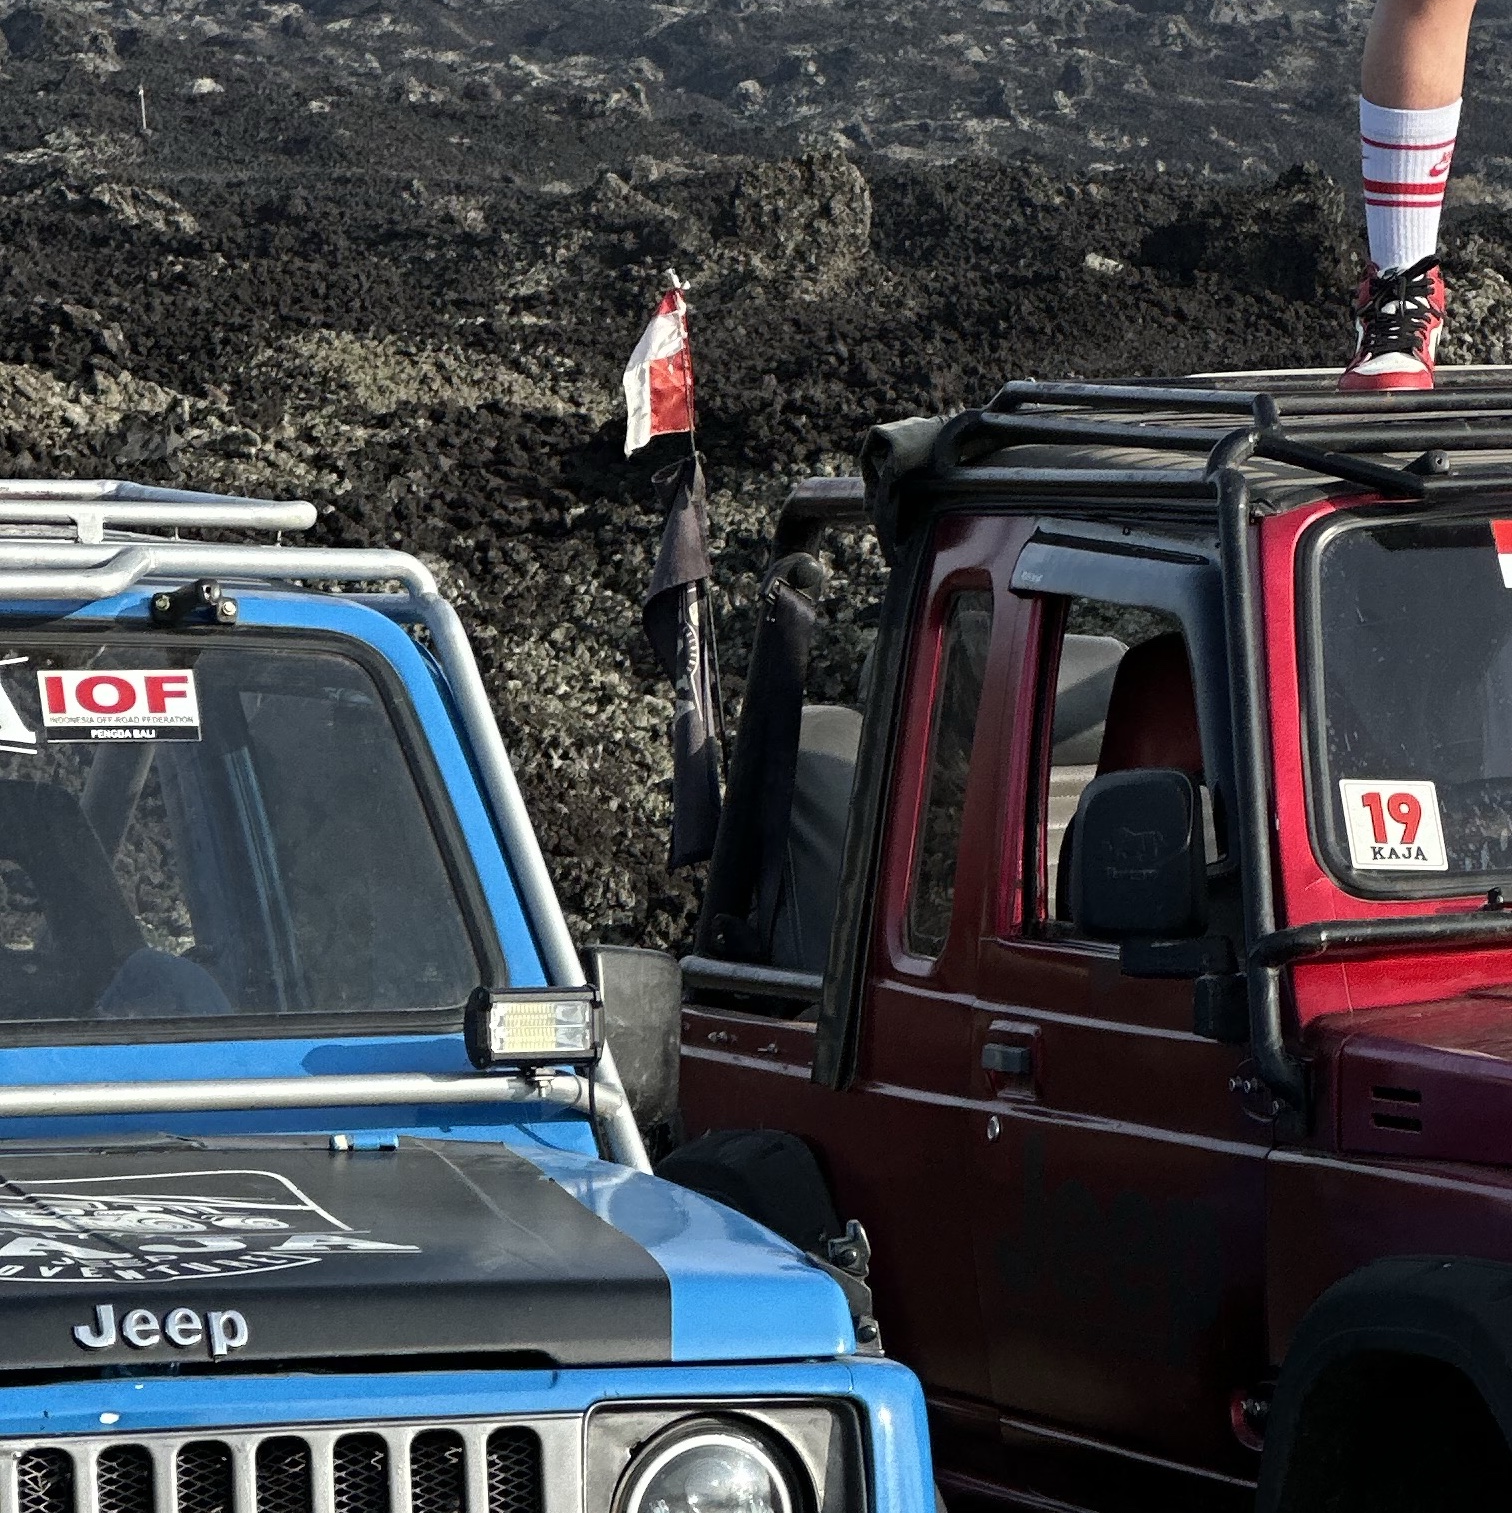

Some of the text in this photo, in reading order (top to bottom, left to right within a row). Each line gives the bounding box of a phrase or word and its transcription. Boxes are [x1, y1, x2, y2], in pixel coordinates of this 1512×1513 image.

[45, 675, 189, 715] IOF
[132, 729, 156, 739] BALI
[1361, 791, 1422, 845] 19
[1370, 846, 1429, 862] KAJA
[73, 1304, 249, 1357] Jeep
